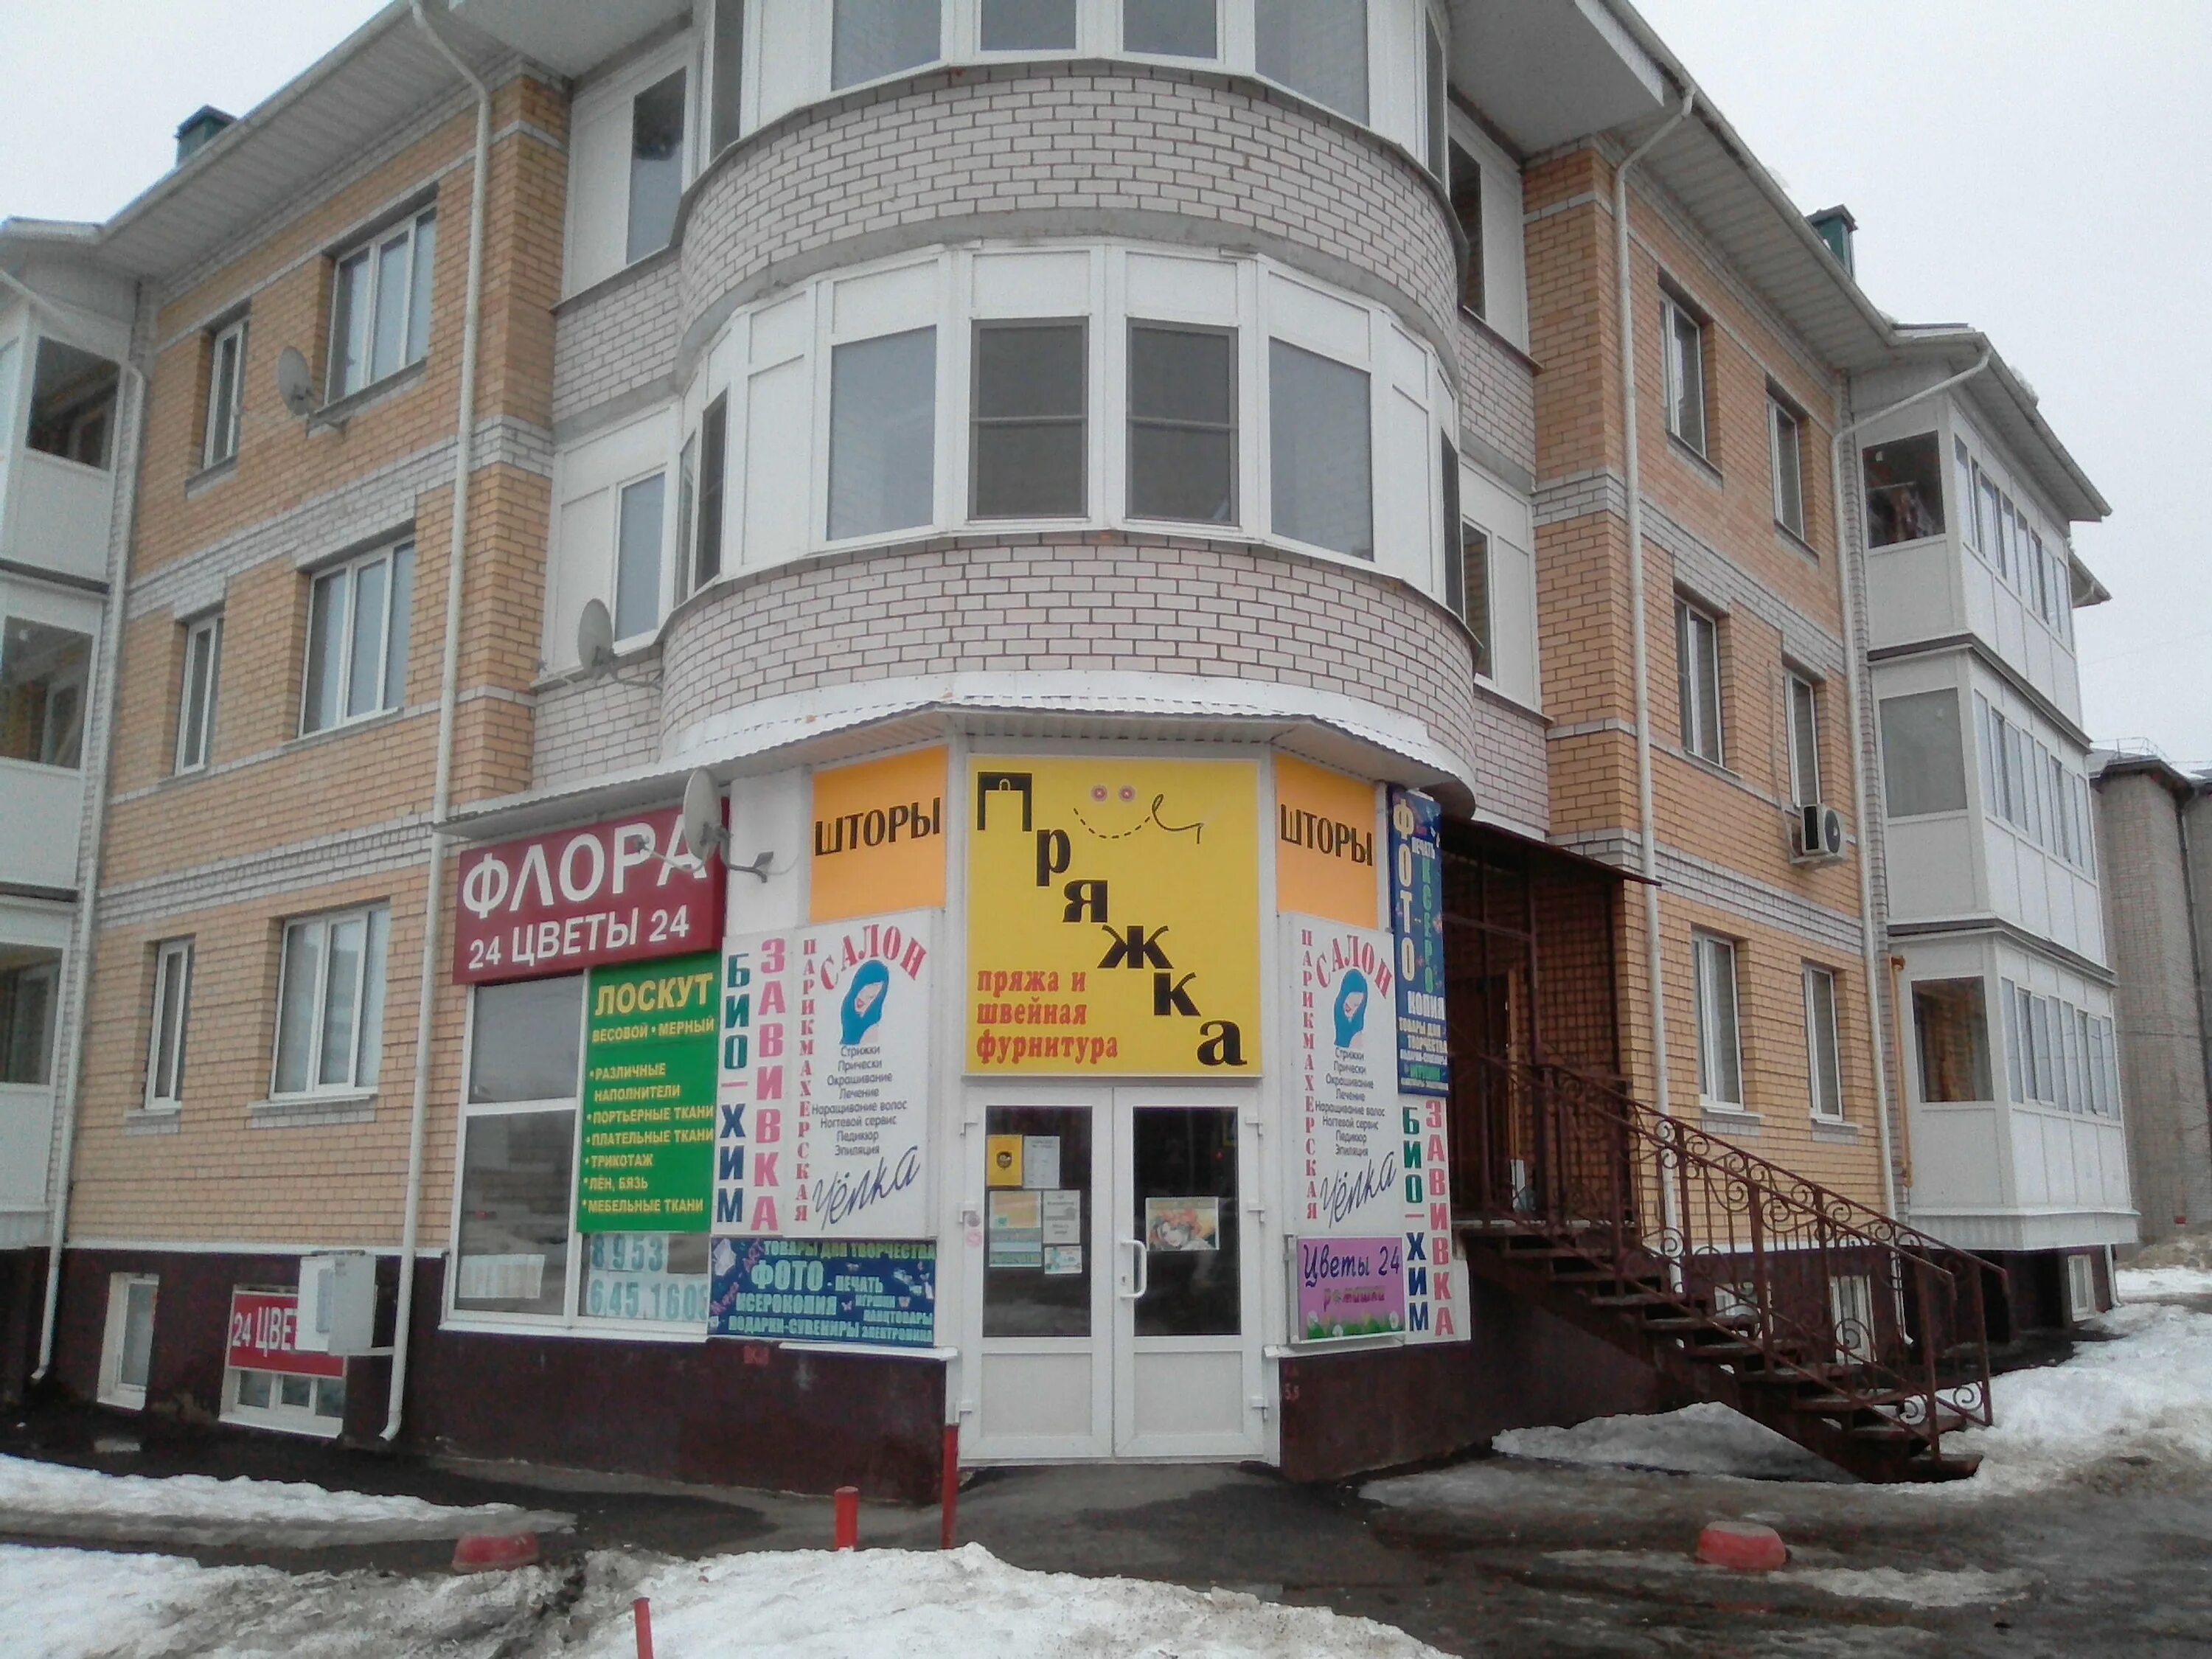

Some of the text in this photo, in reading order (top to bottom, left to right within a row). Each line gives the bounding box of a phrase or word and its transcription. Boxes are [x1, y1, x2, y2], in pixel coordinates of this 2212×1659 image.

[814, 797, 941, 856] ШТОРЫ
[1280, 804, 1373, 866] ШТОРЫ
[462, 814, 708, 919] ФЛОРА
[1392, 799, 1415, 981] ФОТО
[976, 771, 1248, 1066] Пряжка
[468, 905, 689, 969] 24 ЦВЕТЫ 24
[820, 924, 928, 991] САЛОН
[1315, 934, 1393, 999] САЛОН
[595, 973, 714, 1015] ЛОСКУТ
[977, 970, 1086, 998] пряжа и
[977, 997, 1087, 1025] швейная
[1408, 990, 1444, 1020] КОПИЯ
[592, 1015, 714, 1043] ВЕСОВОЙ МЕРНЫЙ
[841, 1046, 880, 1058] Стрижки
[977, 1029, 1119, 1064] фурнитура
[1335, 1048, 1365, 1061] Стрижки
[595, 1062, 667, 1080] РАЗЛИЧНЫЕ
[794, 938, 816, 1222] ПАРИКМАХЕРСКАЯ
[838, 1059, 883, 1073] Прически
[1301, 928, 1318, 1220] ПАРИКМАХЕРСКАЯ
[1333, 1061, 1366, 1075] Прически
[594, 1085, 681, 1102] НАПОЛНИТЕЛИ
[751, 938, 786, 1231] ЗАВИВКА
[827, 1073, 893, 1088] Окрашивание
[839, 1088, 880, 1099] Лечение
[593, 1103, 714, 1124] ПОРТЬЕРНЫЕ ТКАНИ
[812, 1100, 908, 1116] Наращивание волос
[820, 1116, 897, 1128] Ногтевой сервис
[591, 1127, 714, 1146] ПЛАТЕЛЬНЫЕ ТКАНИ
[835, 1144, 880, 1156] Эпиляция
[837, 1130, 879, 1143] Педикюр
[591, 1154, 653, 1168] ТРИКОТАЖ
[618, 1177, 648, 1190] БЯЗЬ
[588, 1198, 703, 1214] МЕБЕЛЬНЫЕ ТКАНИ
[1425, 1100, 1454, 1336] ЗАВИВКА
[763, 1240, 818, 1256] ТОВАРЫ
[751, 1259, 824, 1291] ФОТО
[1304, 1244, 1400, 1287] Цветы 24
[736, 1293, 837, 1315] КСЕРОКОПИЯ
[232, 1307, 297, 1357] 24 ЦВЕ
